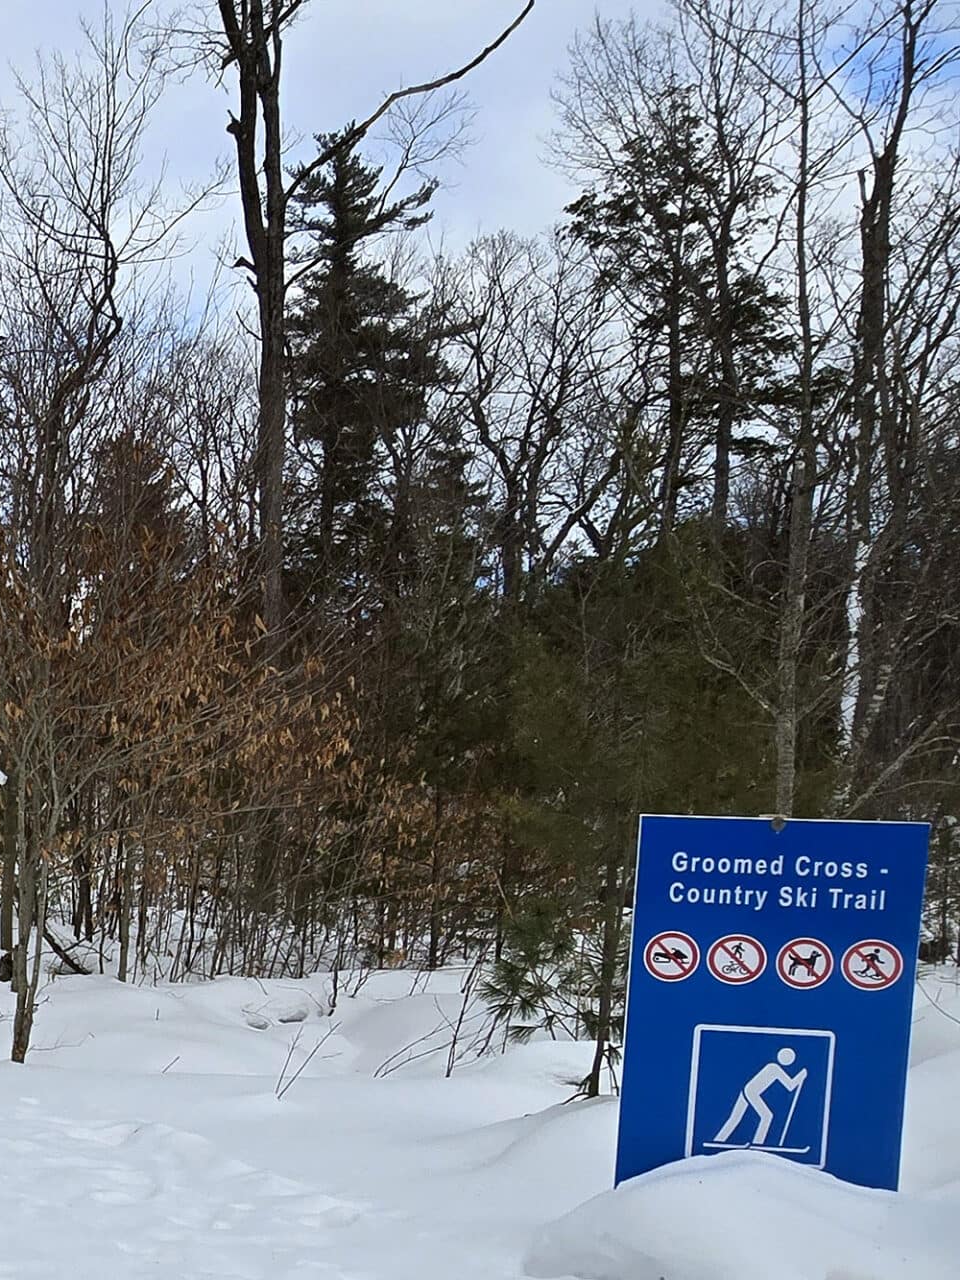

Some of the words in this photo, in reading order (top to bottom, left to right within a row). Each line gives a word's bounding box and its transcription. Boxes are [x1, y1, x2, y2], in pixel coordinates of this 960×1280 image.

[671, 851, 784, 875] Groomed
[795, 855, 868, 878] Cross
[669, 882, 768, 911] Country
[779, 886, 817, 908] Ski
[829, 888, 885, 910] Trail
